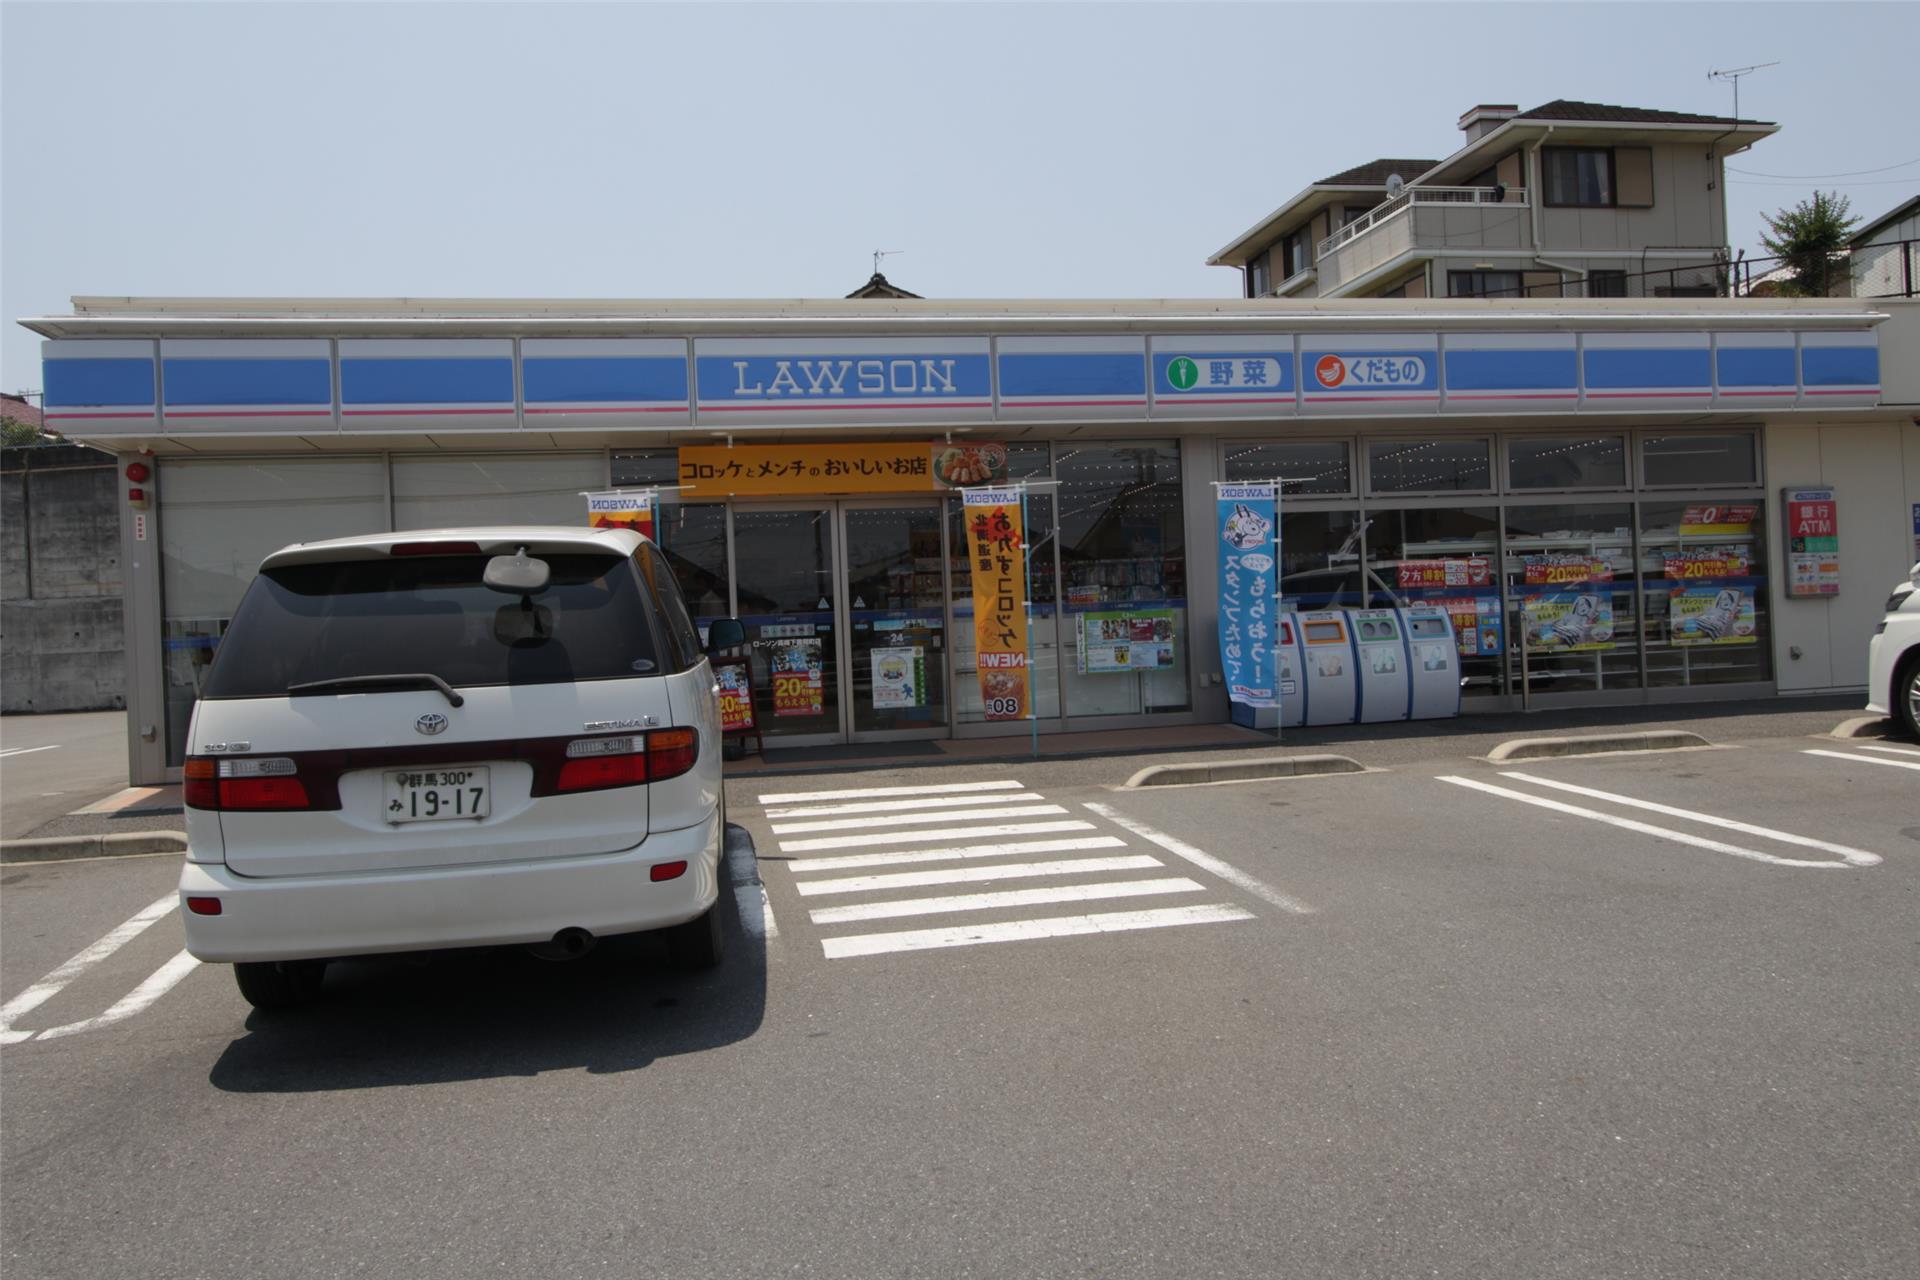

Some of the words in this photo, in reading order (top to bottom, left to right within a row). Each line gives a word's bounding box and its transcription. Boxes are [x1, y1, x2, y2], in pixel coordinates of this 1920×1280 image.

[733, 360, 956, 394] LAWSON
[1209, 360, 1267, 385] 野菜
[1349, 359, 1419, 383] くだもの
[1798, 520, 1832, 534] ATM
[1546, 567, 1567, 583] 20
[1684, 562, 1704, 577] 20
[890, 633, 904, 642] 24
[389, 799, 404, 812] み
[411, 787, 484, 817] 19-17
